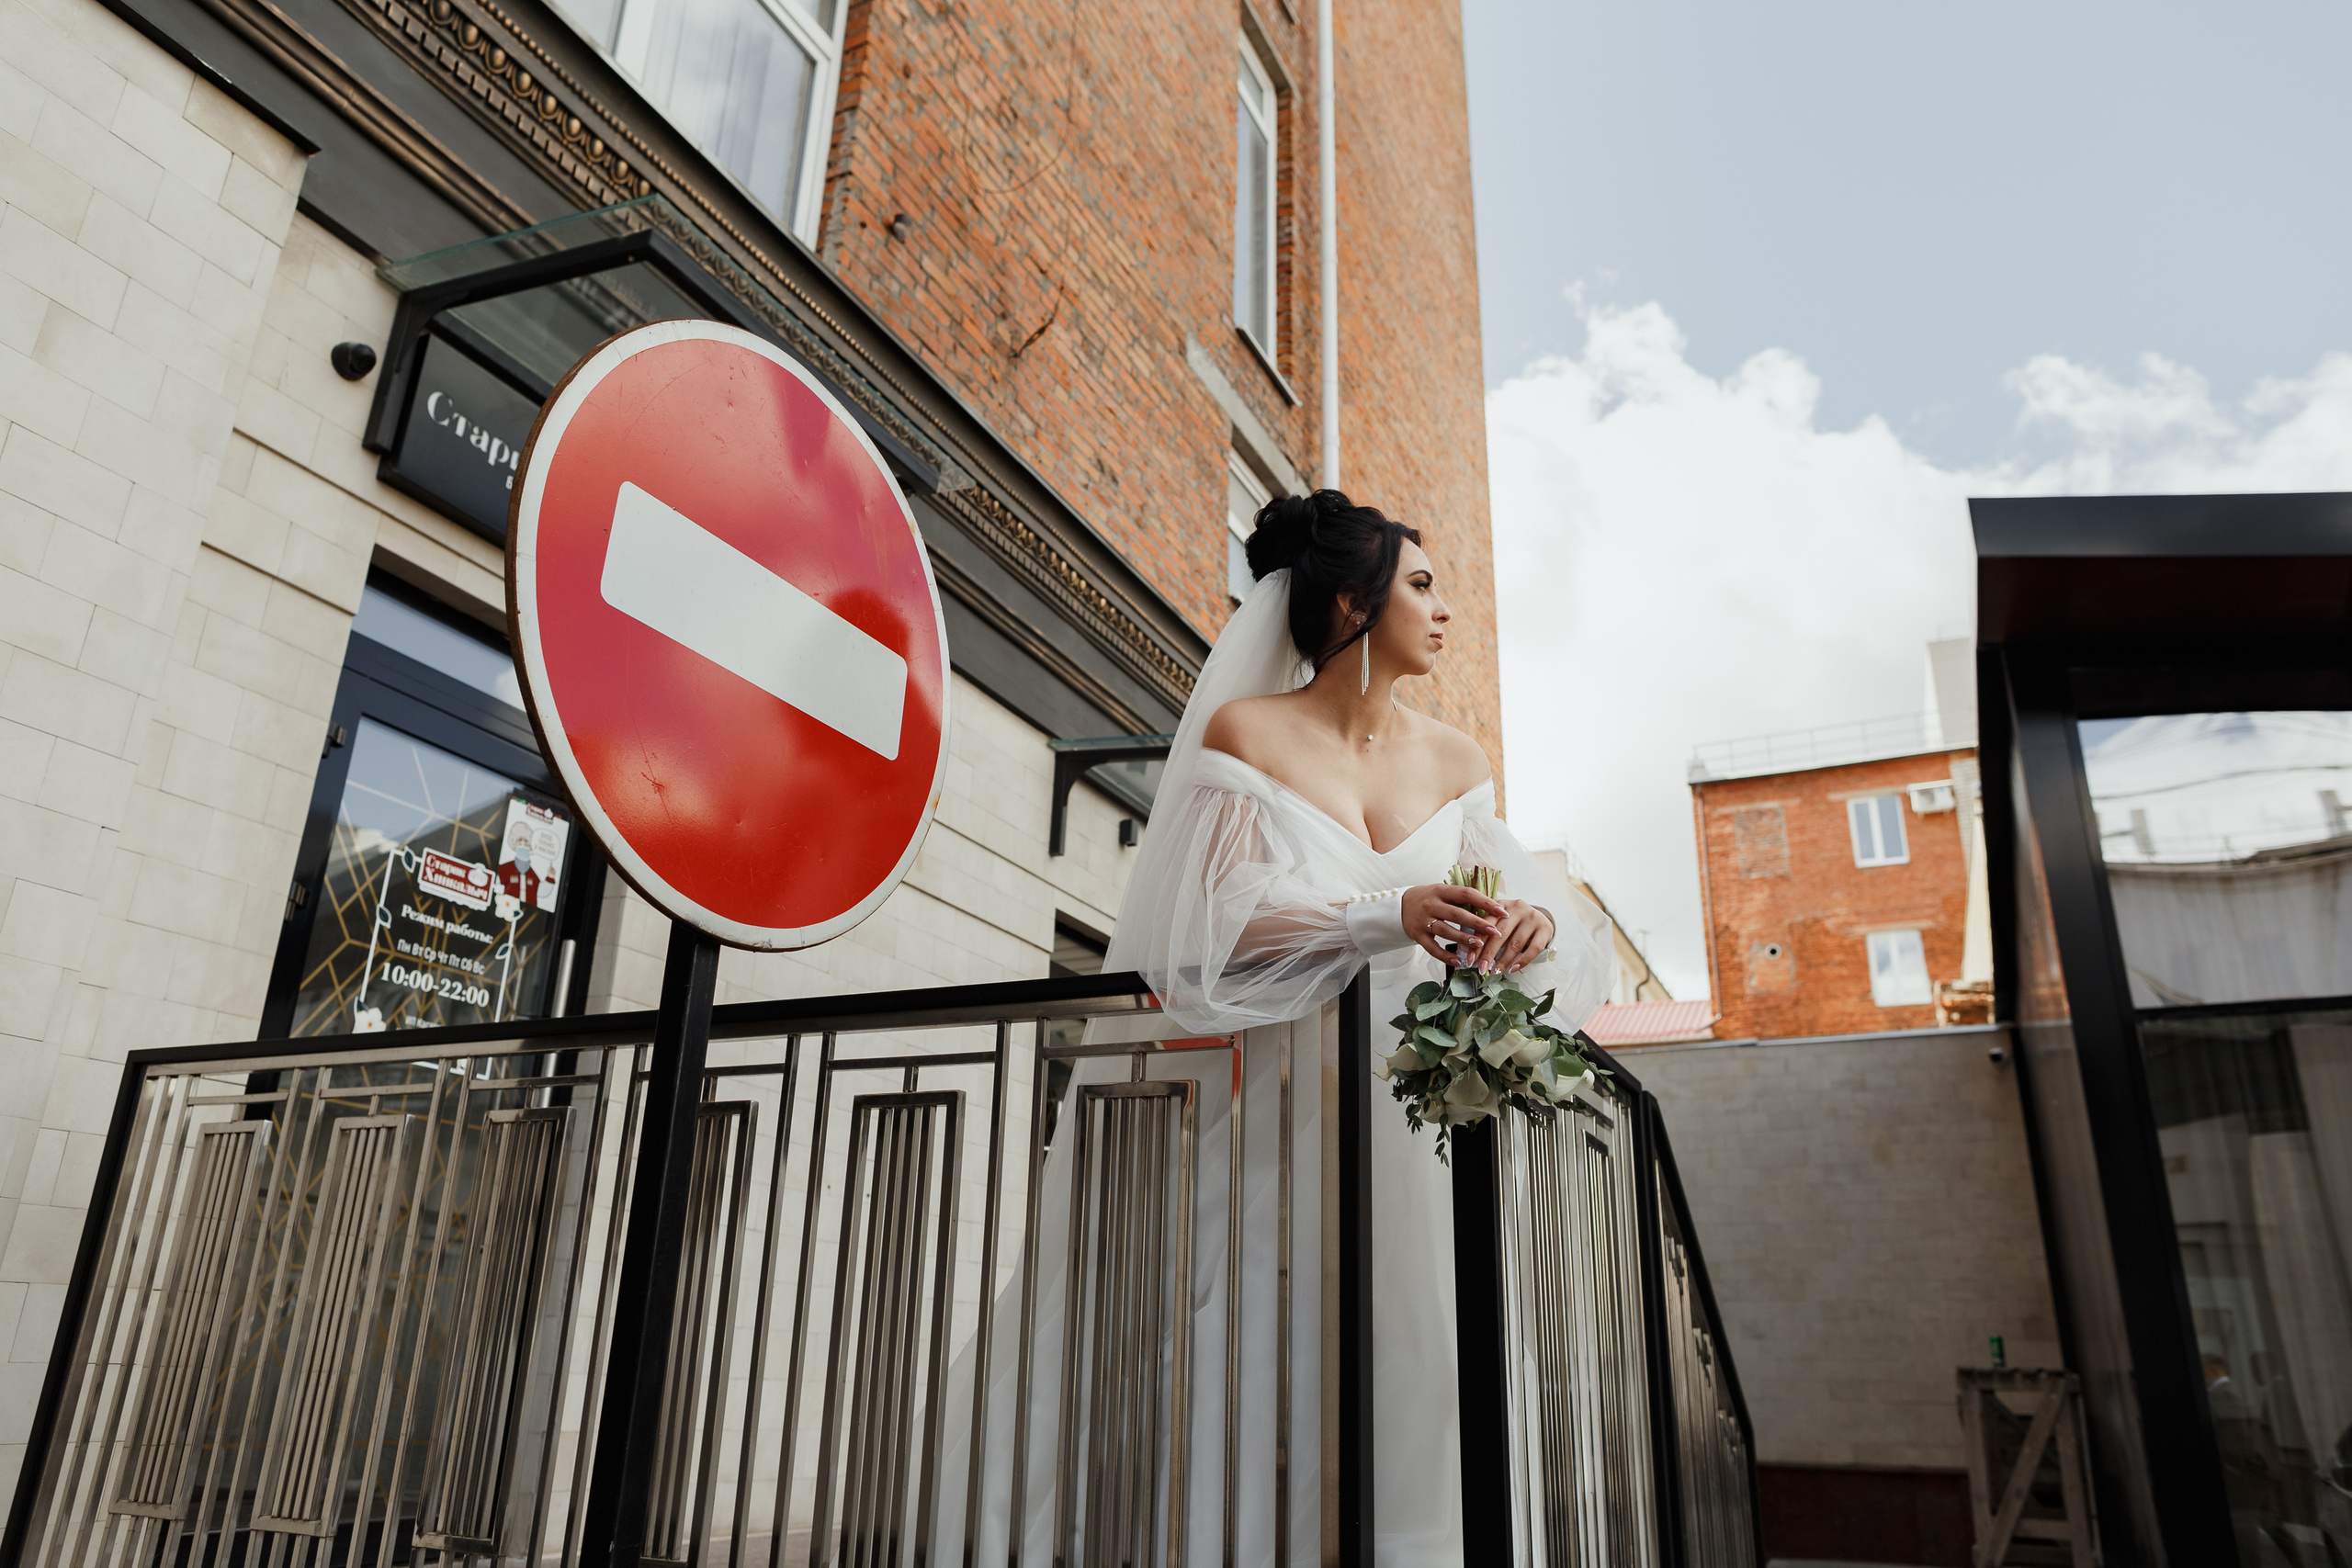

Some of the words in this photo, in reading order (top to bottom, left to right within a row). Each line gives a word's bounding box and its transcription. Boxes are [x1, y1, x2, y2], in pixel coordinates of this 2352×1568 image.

[401, 904, 445, 930] Режим
[445, 921, 493, 944] работы:
[397, 939, 411, 953] Пн
[412, 942, 424, 957] Вт
[424, 946, 437, 964] Ср
[437, 950, 449, 964] Чт
[448, 953, 461, 967] Пт
[460, 957, 472, 971] Сб
[472, 960, 485, 975] Вс
[381, 962, 490, 1008] 10:00-22:00
